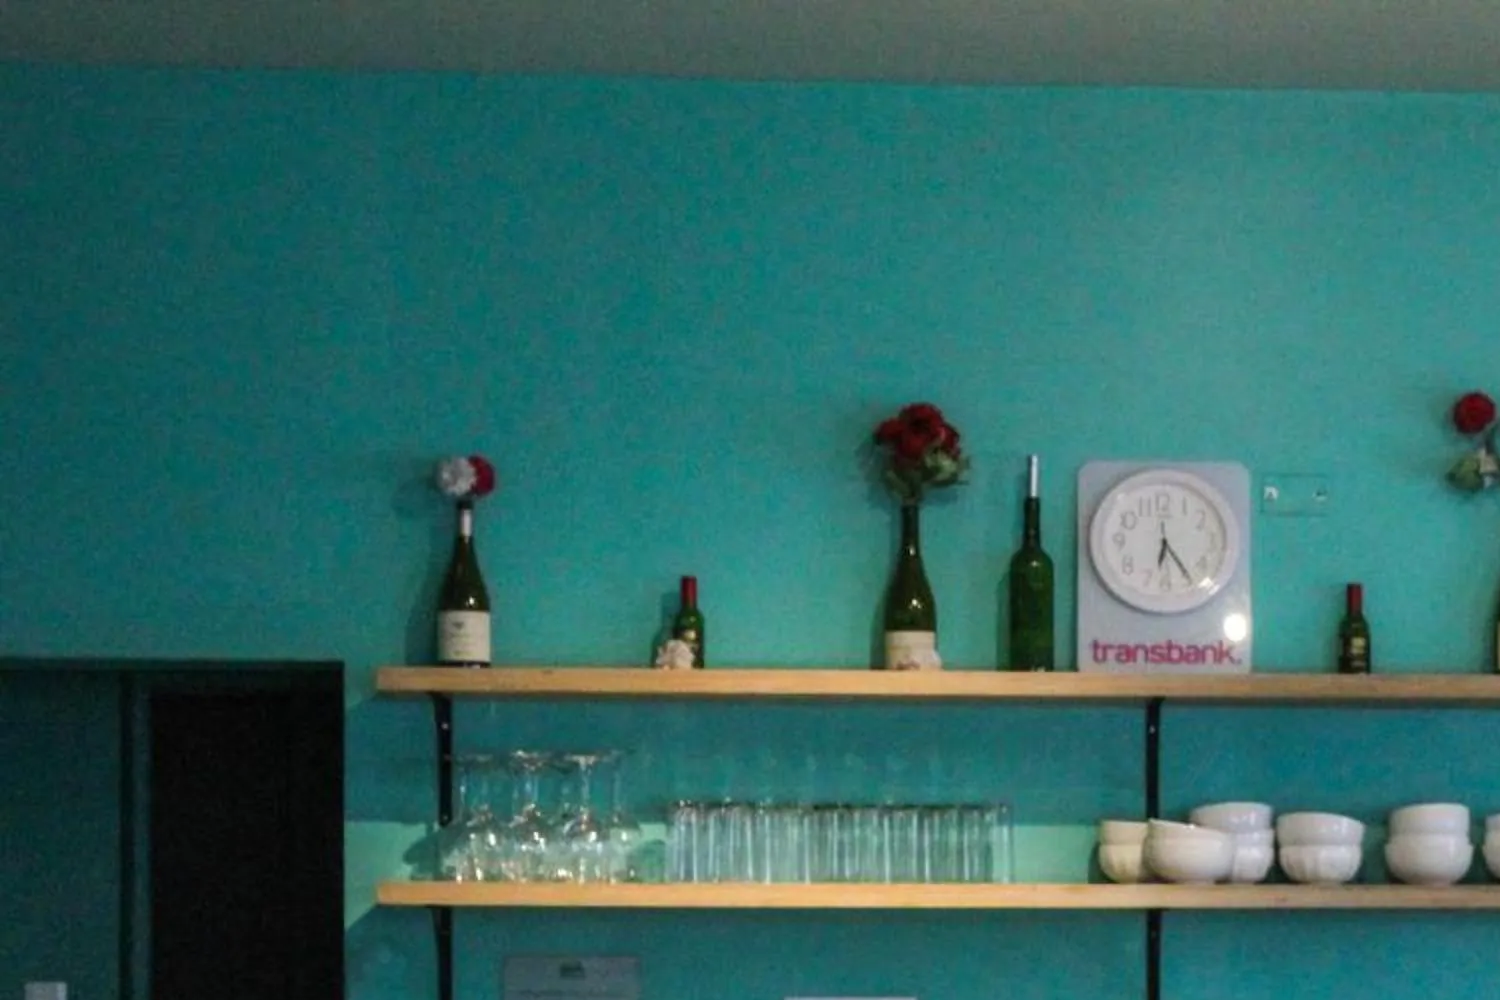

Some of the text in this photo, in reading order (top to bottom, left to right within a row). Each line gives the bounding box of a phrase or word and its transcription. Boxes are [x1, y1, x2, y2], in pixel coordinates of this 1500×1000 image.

[1138, 496, 1152, 517] 11
[1154, 492, 1171, 512] 12
[1119, 511, 1137, 530] 10
[1195, 508, 1206, 531] 2
[1112, 532, 1126, 551] 9
[1121, 555, 1134, 576] 8
[1142, 570, 1153, 587] 7
